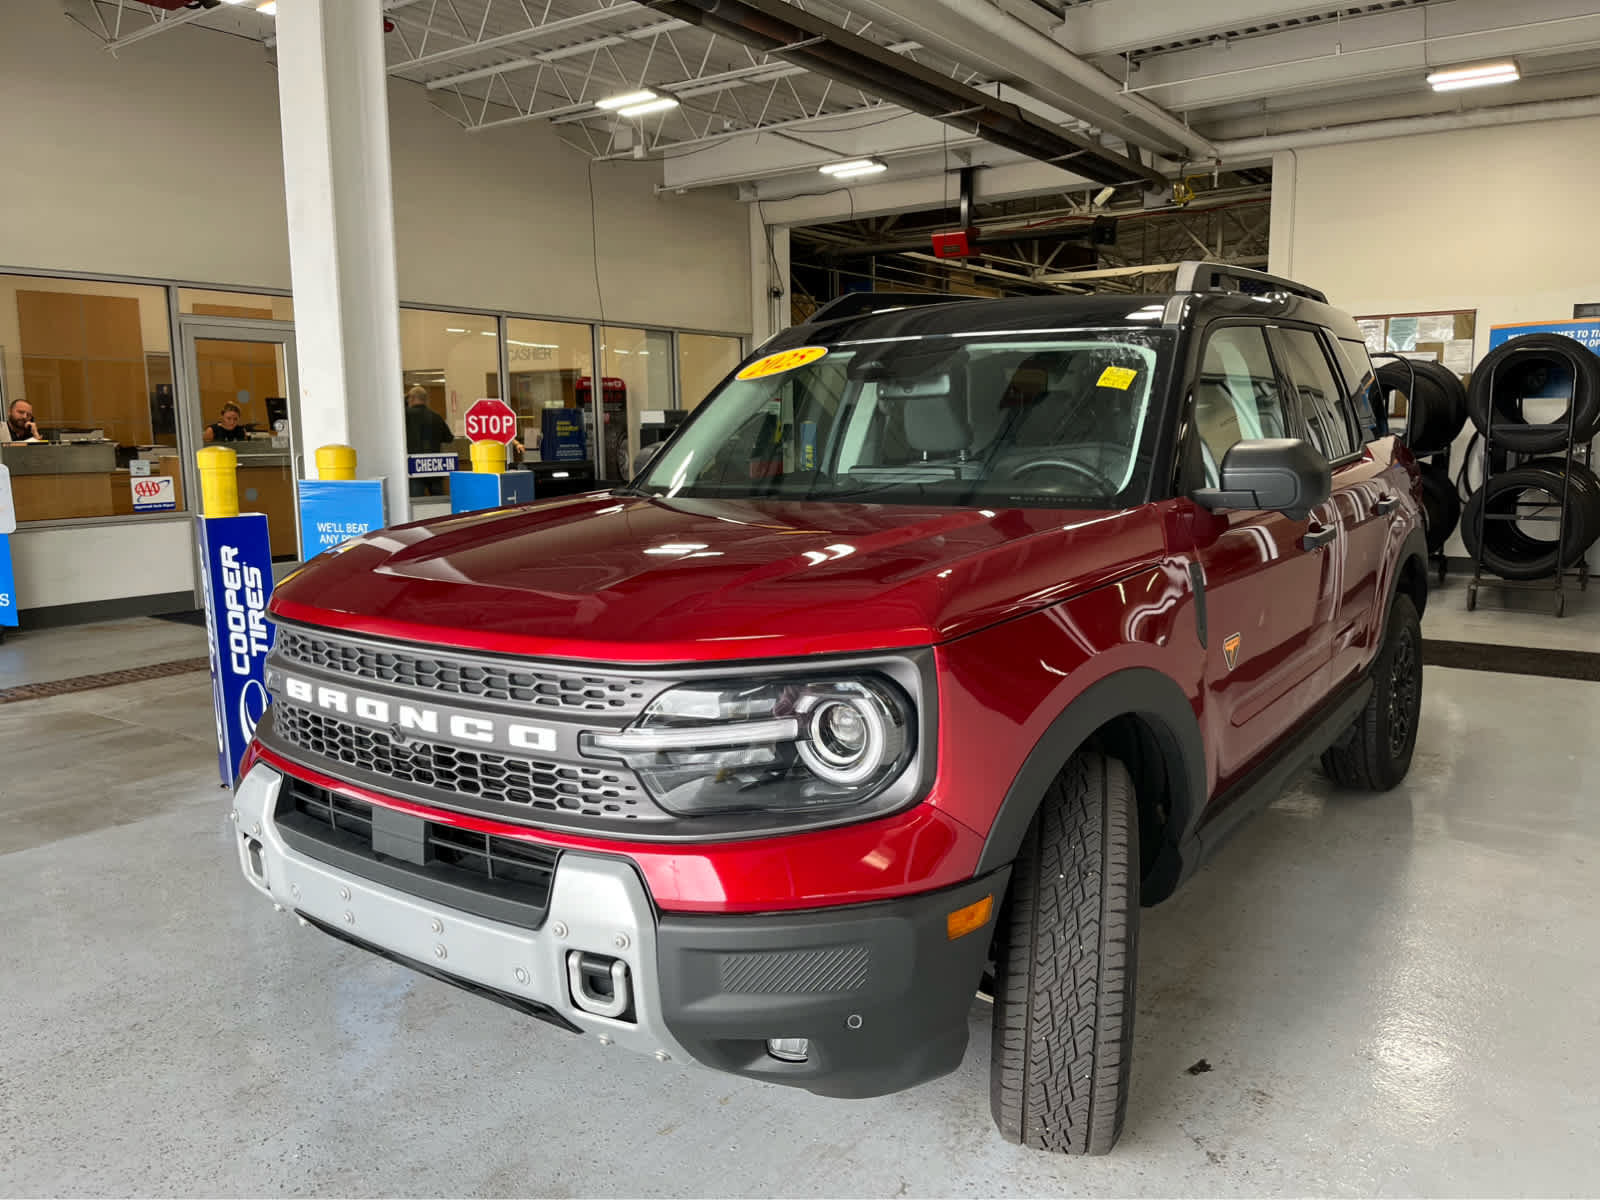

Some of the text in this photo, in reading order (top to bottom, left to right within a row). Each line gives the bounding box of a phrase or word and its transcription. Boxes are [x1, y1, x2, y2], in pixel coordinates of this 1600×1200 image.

[1577, 329, 1589, 338] TO
[468, 415, 513, 434] STOP
[415, 457, 455, 472] CHECK-IN
[135, 480, 161, 497] AAA
[316, 522, 369, 534] WE'LL BEAT
[320, 534, 339, 545] ANY
[220, 545, 250, 675] COOPER
[243, 564, 269, 657] TIRES
[285, 677, 557, 751] BRONCO
